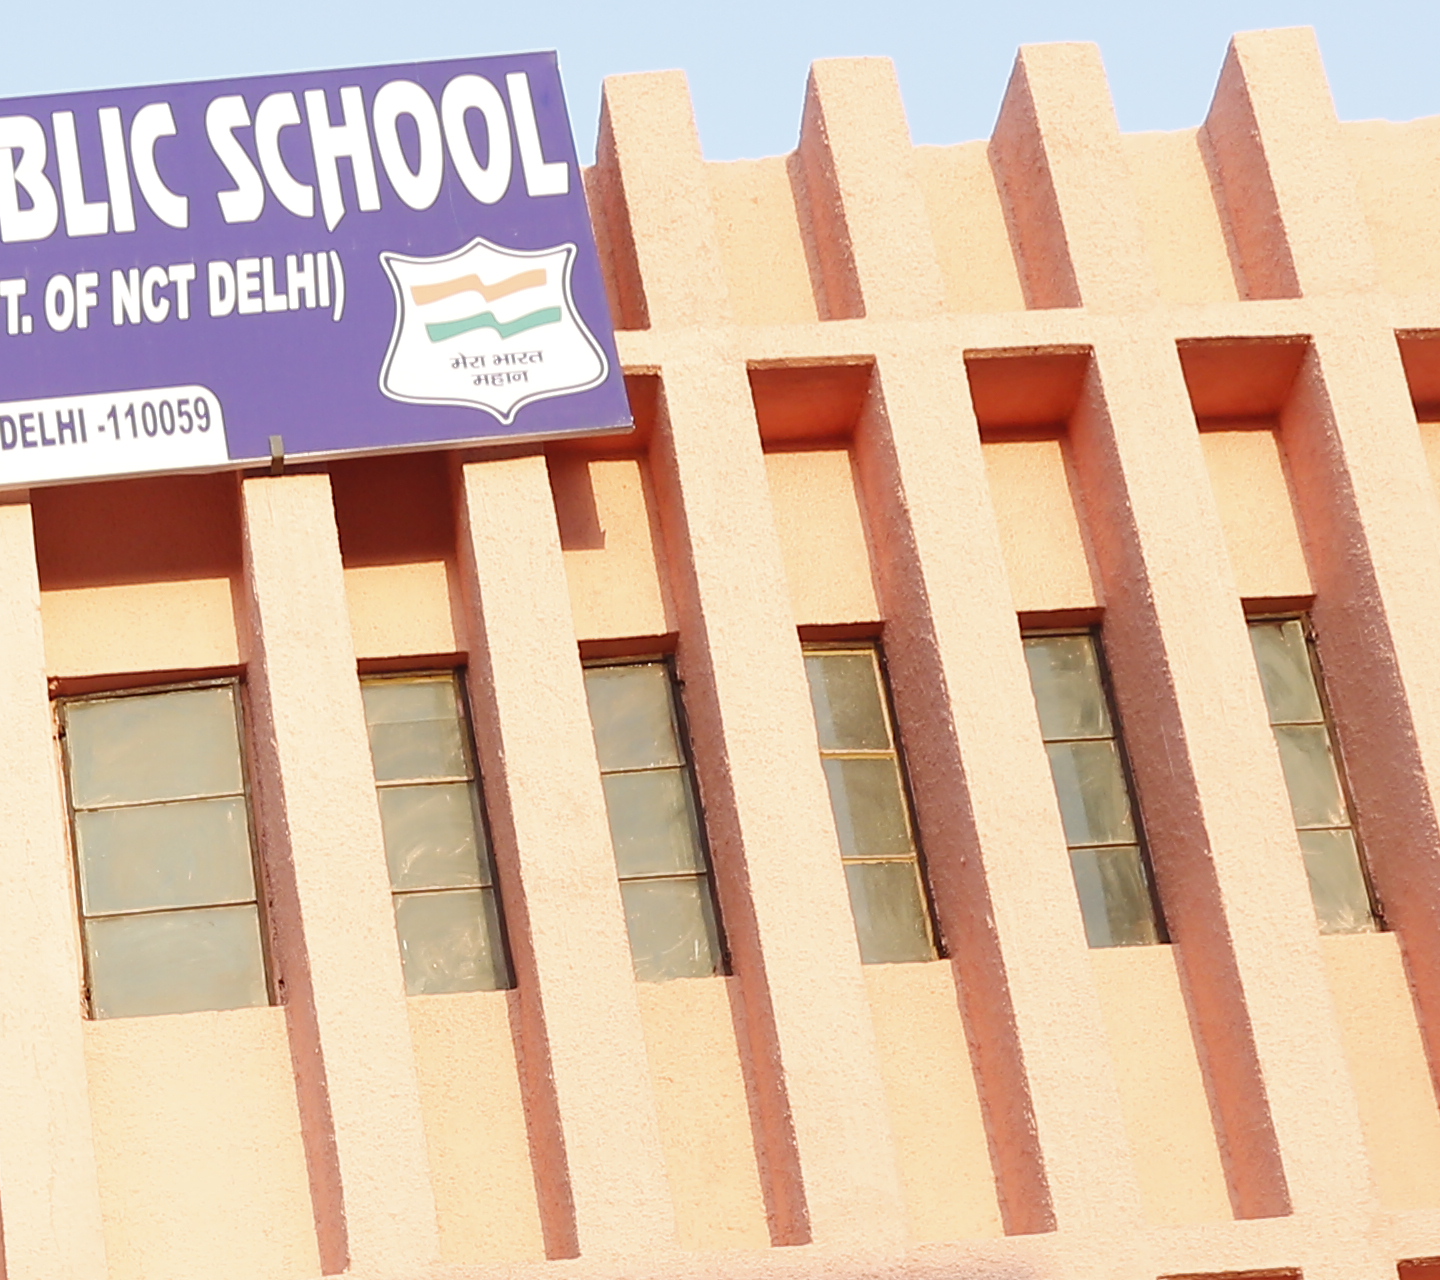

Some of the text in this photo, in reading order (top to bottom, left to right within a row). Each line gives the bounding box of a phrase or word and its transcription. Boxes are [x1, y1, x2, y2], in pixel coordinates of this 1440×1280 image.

[205, 71, 569, 233] SCHOOL
[45, 272, 99, 331] OF
[111, 263, 197, 326] NCT
[208, 250, 346, 322] DELHI)
[450, 349, 544, 372] मेरा भारत
[472, 369, 529, 388] महान
[0, 407, 88, 451] DELHI
[98, 397, 211, 441] -110059
